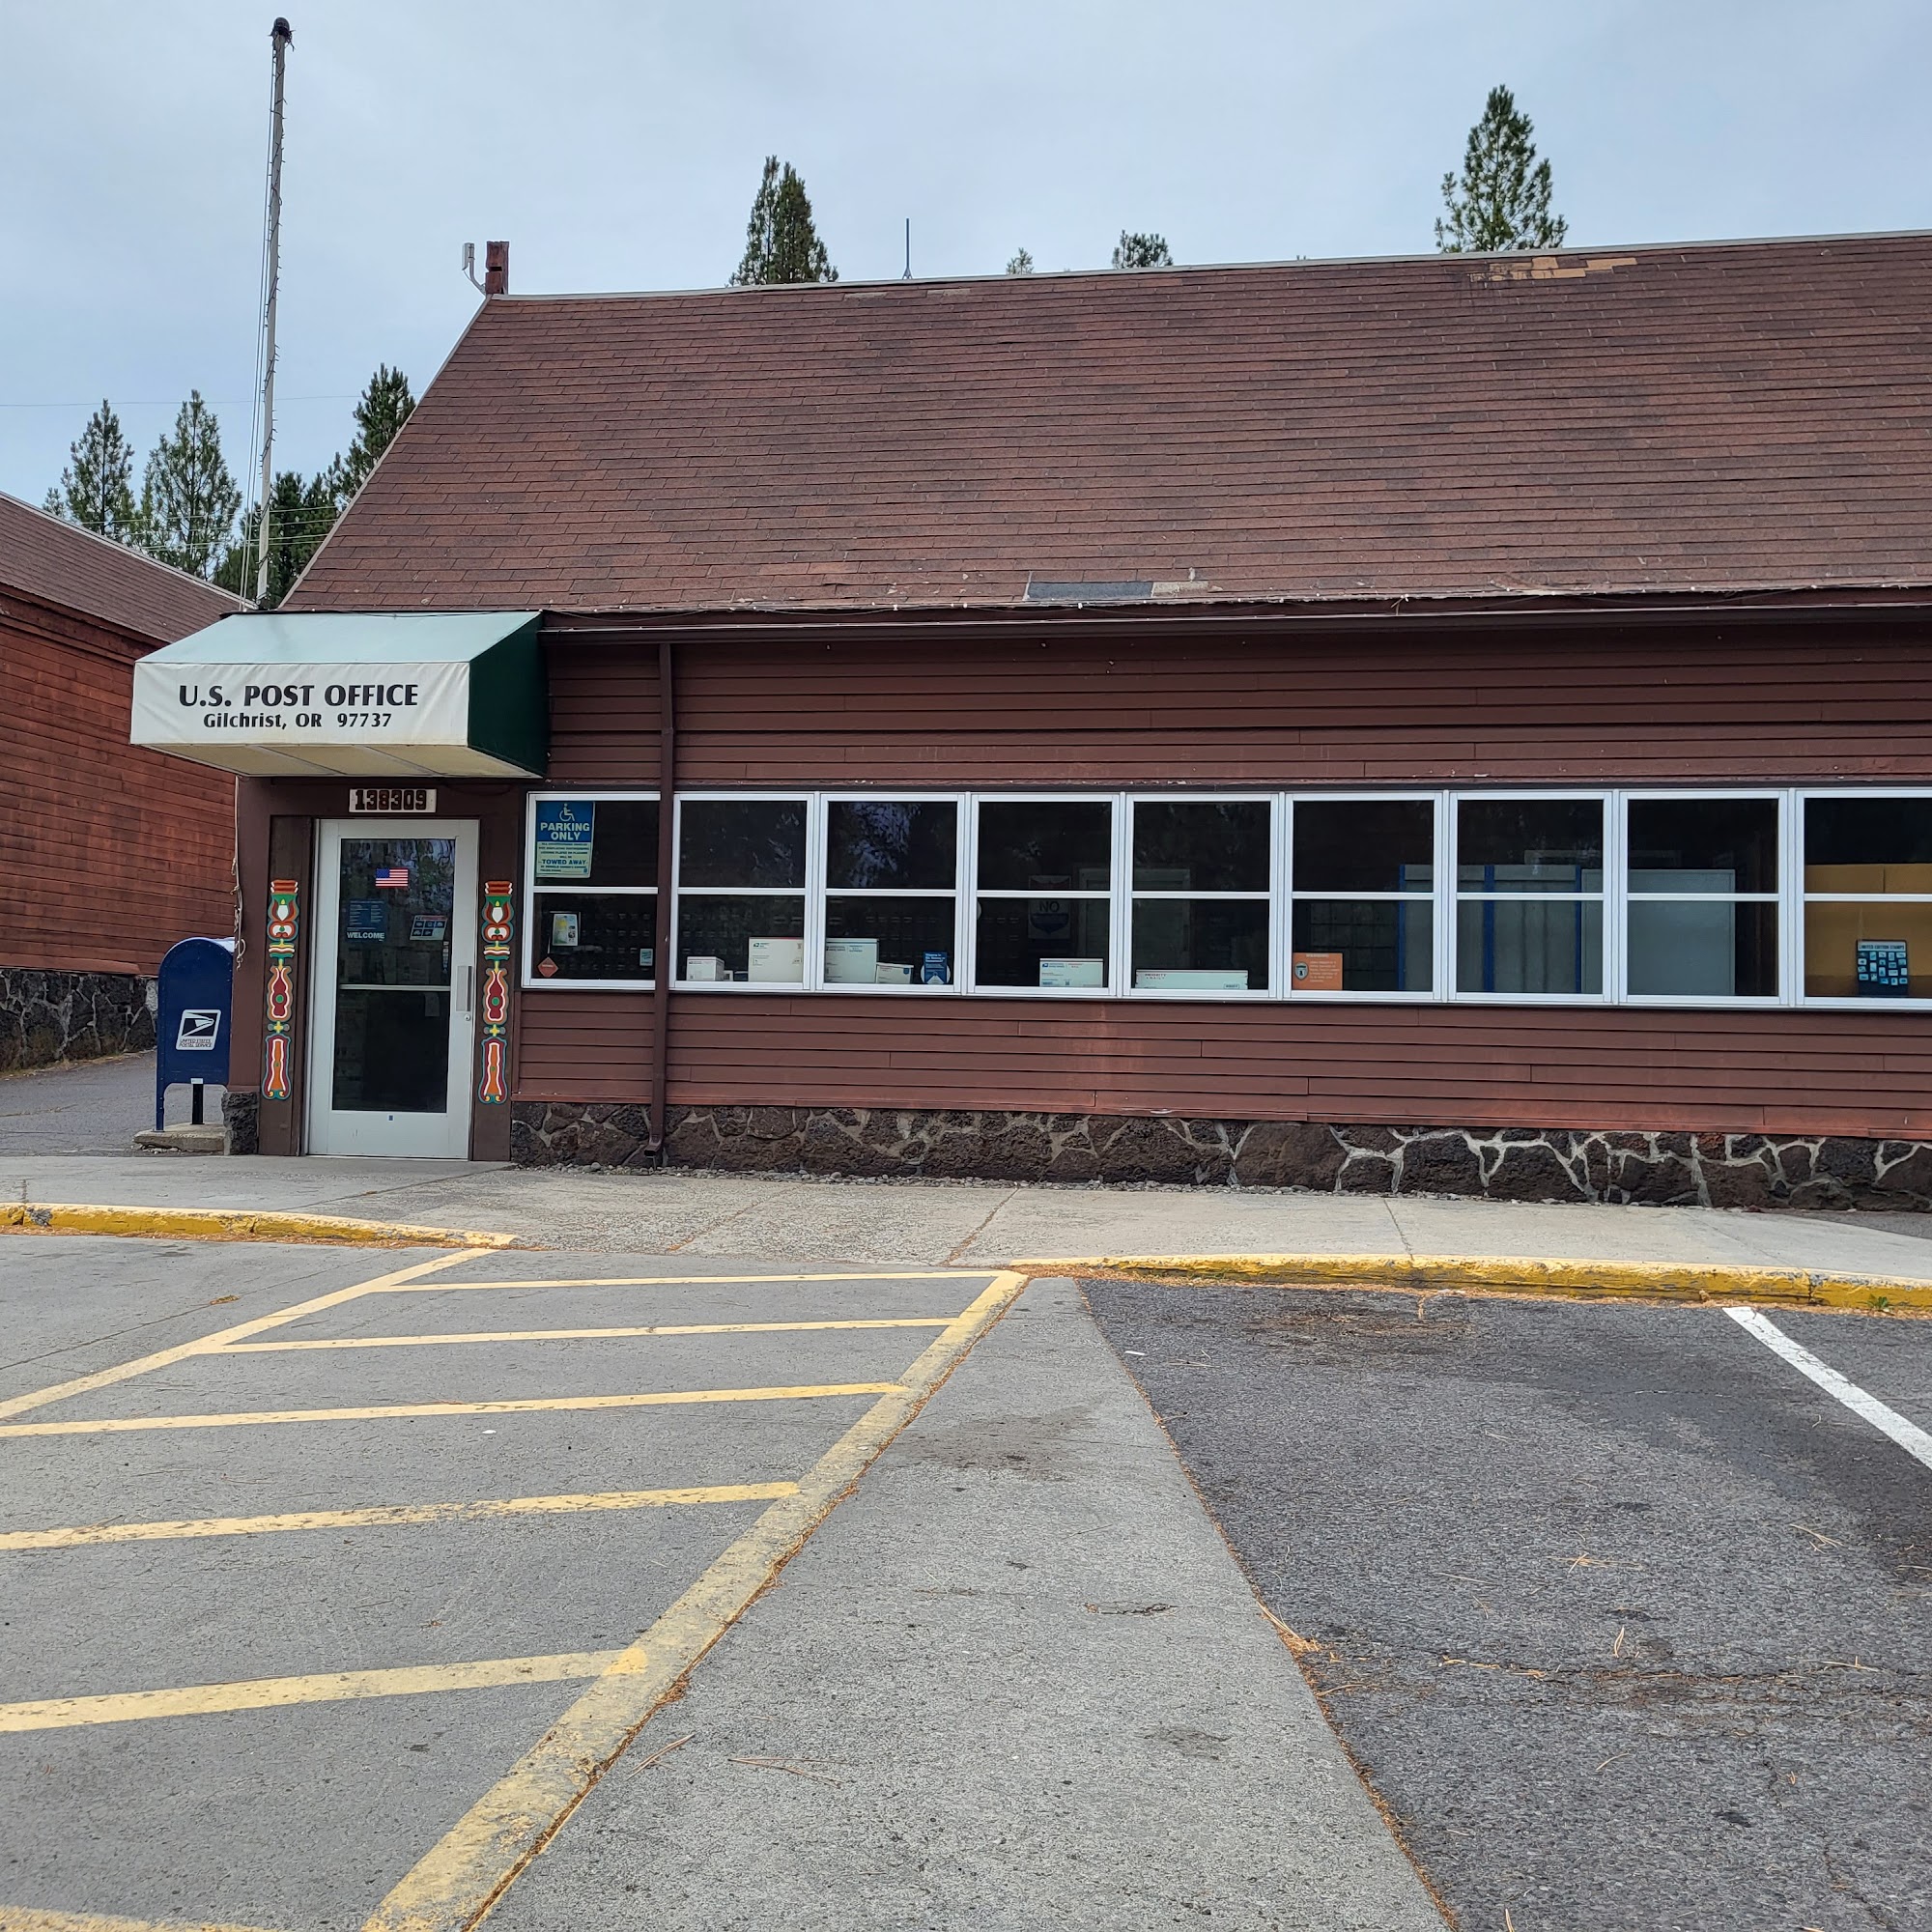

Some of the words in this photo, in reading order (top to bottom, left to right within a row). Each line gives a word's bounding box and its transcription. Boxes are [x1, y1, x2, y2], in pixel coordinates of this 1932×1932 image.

[179, 685, 232, 707] U.S.
[243, 685, 315, 707] POST
[324, 684, 419, 706] OFFICE
[203, 713, 287, 730] Gilchrist,
[295, 713, 323, 727] OR
[337, 713, 392, 727] 97737
[355, 789, 427, 810] 138309
[540, 822, 590, 832] PARKING
[551, 831, 582, 840] ONLY
[1038, 900, 1061, 913] NO
